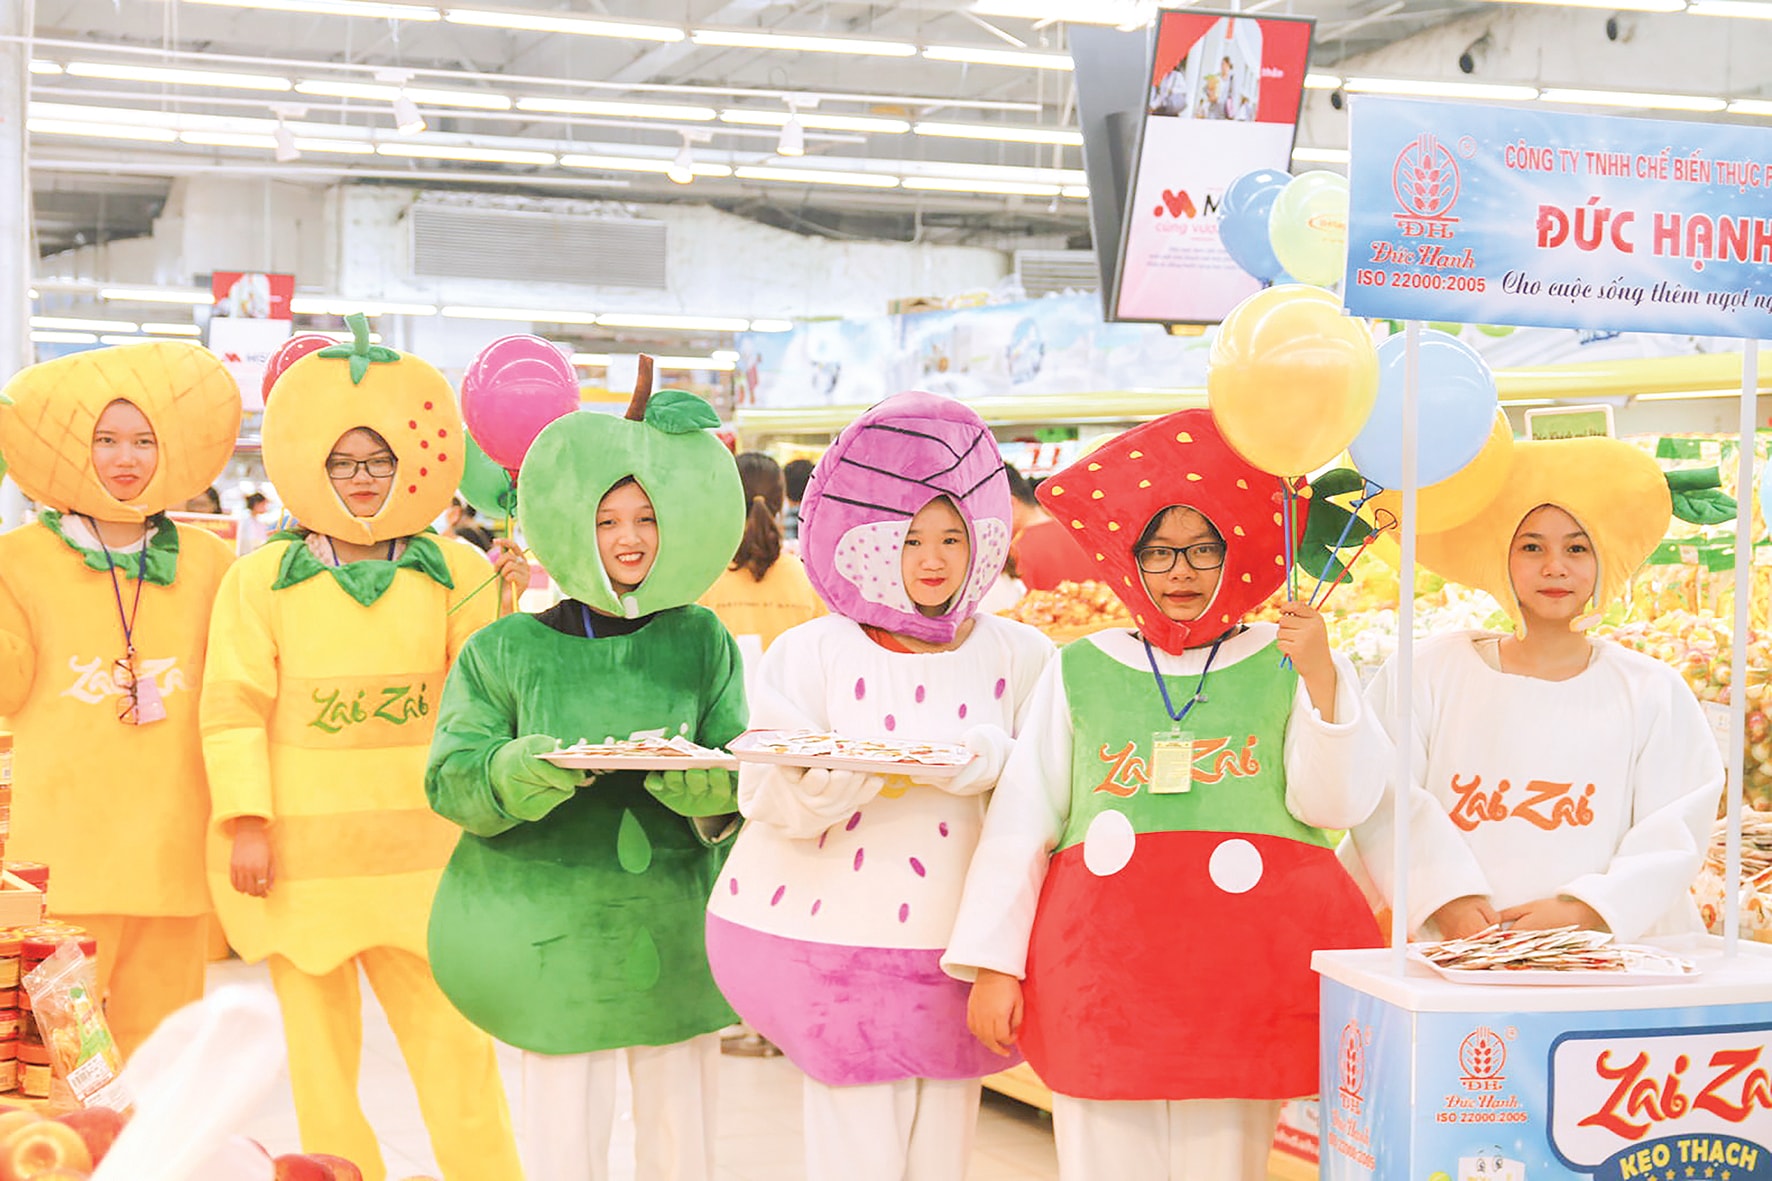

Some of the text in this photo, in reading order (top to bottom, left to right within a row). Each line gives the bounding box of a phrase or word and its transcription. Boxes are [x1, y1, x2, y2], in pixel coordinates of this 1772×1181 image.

[1504, 139, 1554, 172] CÔNG
[1558, 149, 1580, 174] TY
[1584, 151, 1631, 177] TNHH
[1635, 146, 1672, 180] CHẾ
[1673, 149, 1711, 183] BIẾN
[1716, 159, 1760, 194] THỰC
[1536, 196, 1772, 272] ĐỨC HẠNH
[1357, 269, 1487, 293] ISO 22000:2005
[1502, 270, 1542, 296] Cho
[1548, 277, 1593, 304] cuộc
[1597, 276, 1644, 306] sống
[1650, 280, 1701, 305] thêm
[1705, 287, 1752, 314] ngọt
[1092, 741, 1152, 798] Za
[1510, 779, 1596, 831] Zai
[1436, 1112, 1457, 1123] ISO
[1619, 1138, 1759, 1181] KẸO THẠCH
